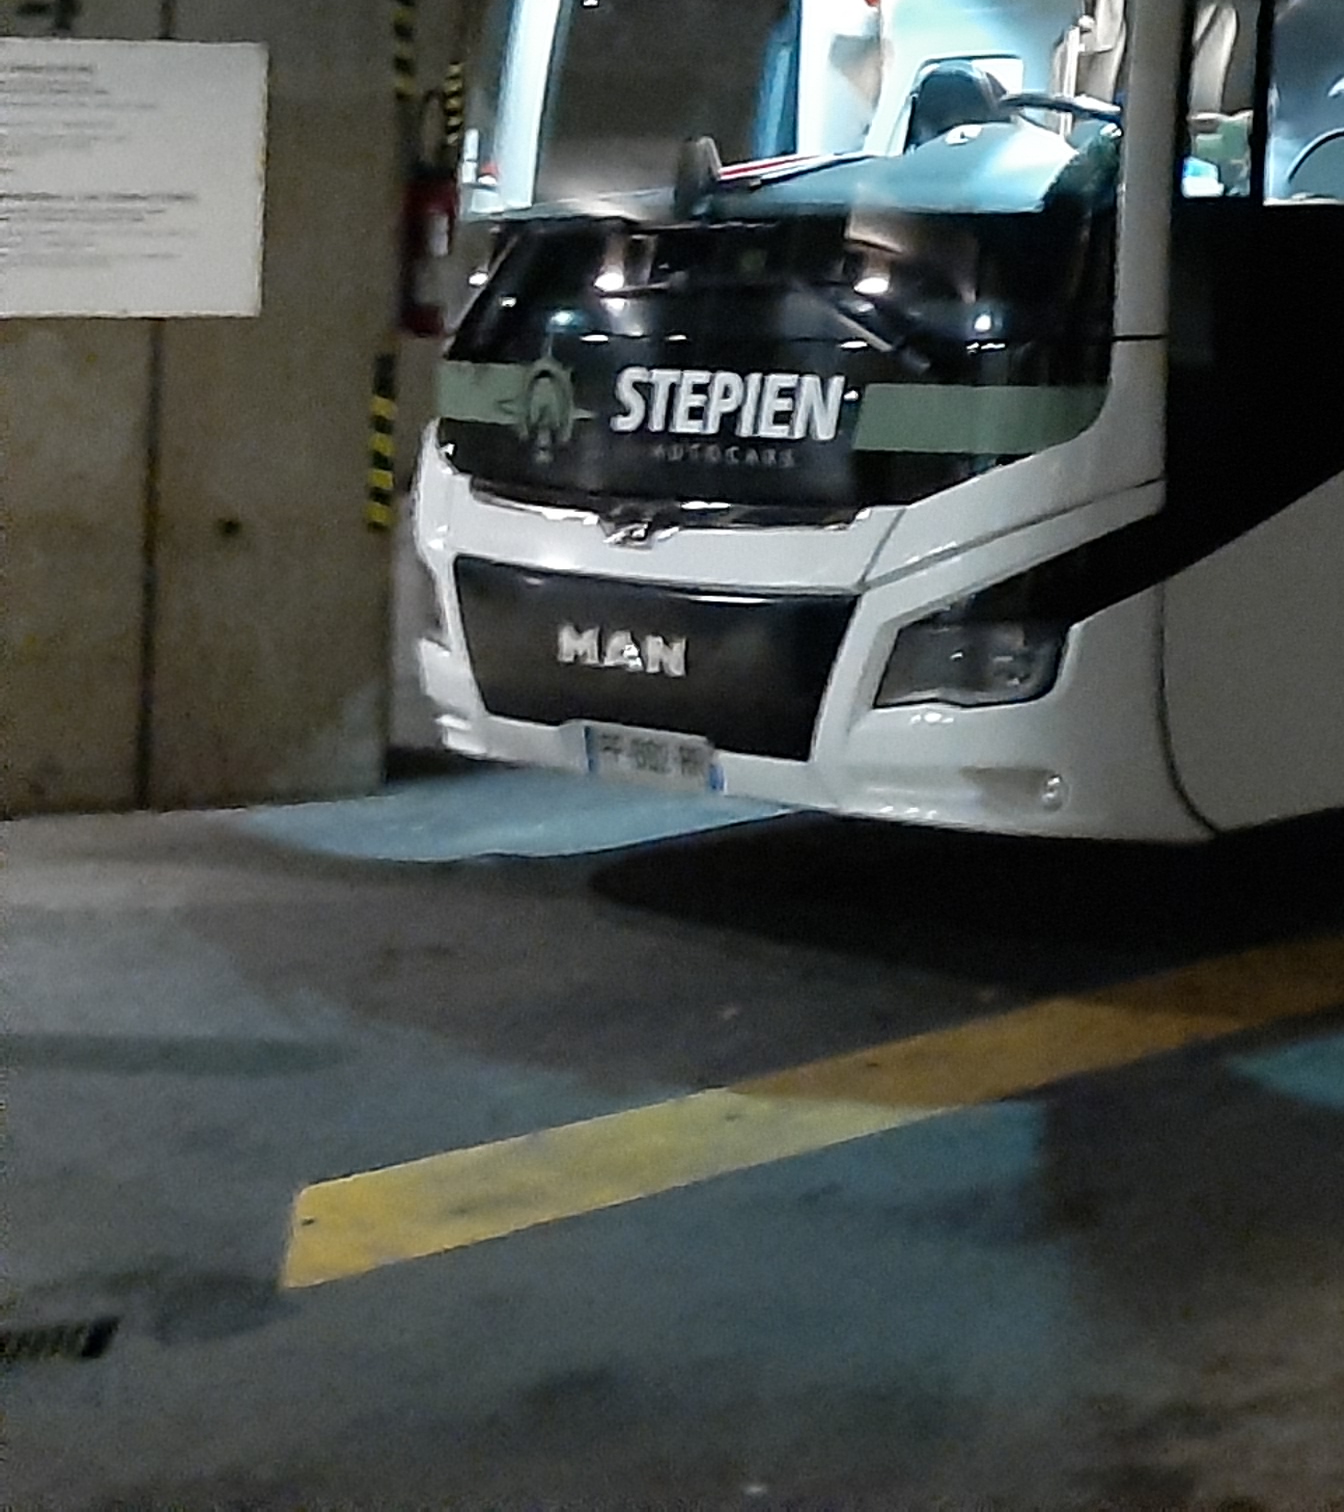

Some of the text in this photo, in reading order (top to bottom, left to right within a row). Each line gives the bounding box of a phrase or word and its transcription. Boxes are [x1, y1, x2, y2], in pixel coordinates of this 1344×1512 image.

[610, 367, 844, 440] STEPIEN
[652, 444, 796, 466] AUTOCARS
[558, 625, 687, 676] MAN
